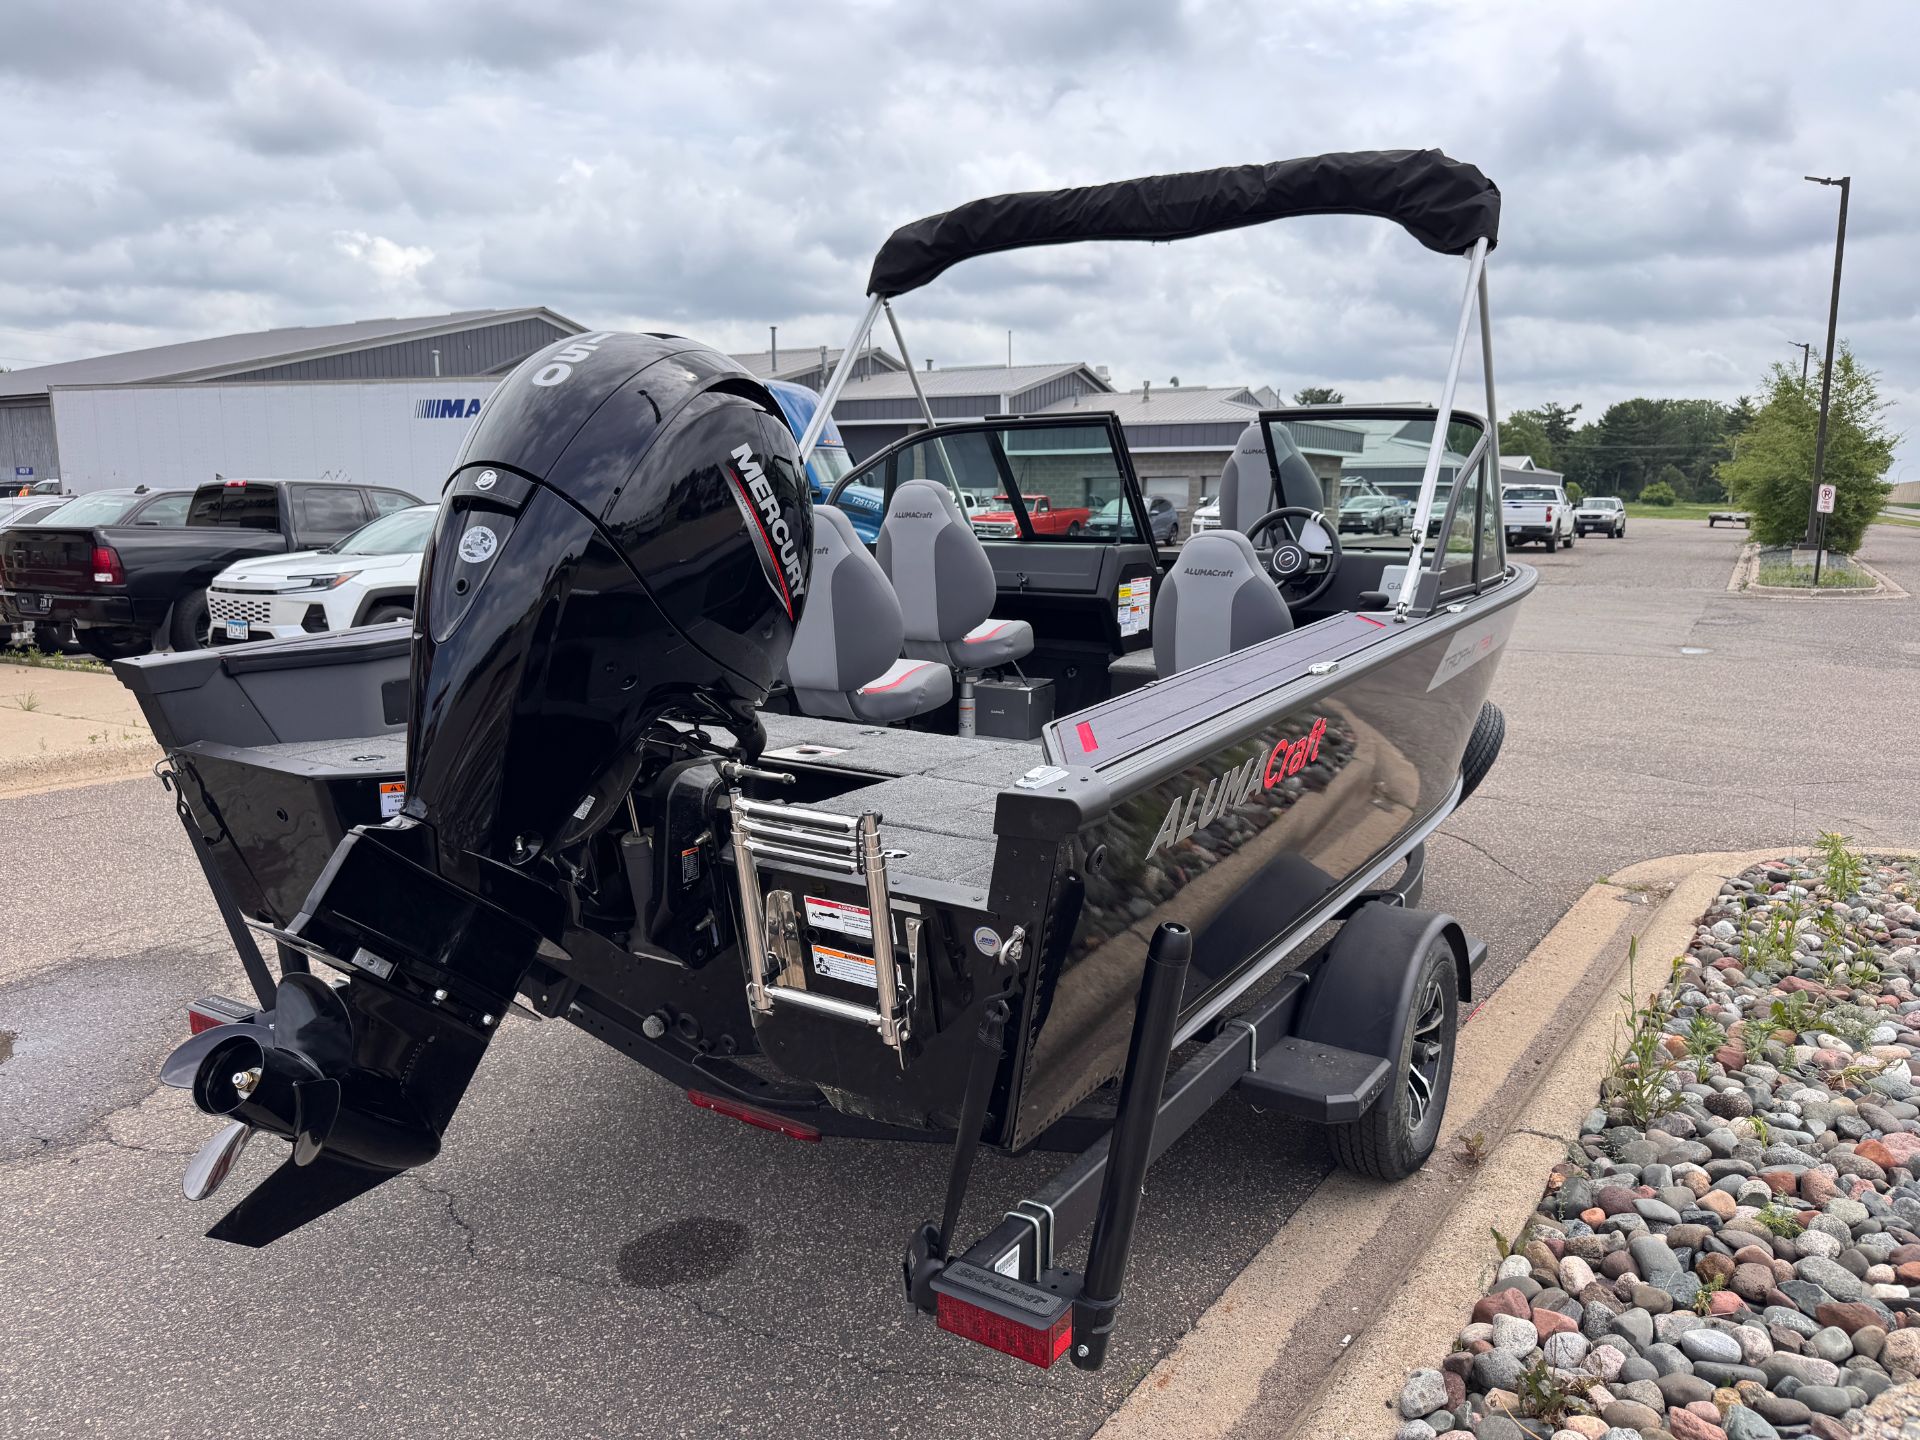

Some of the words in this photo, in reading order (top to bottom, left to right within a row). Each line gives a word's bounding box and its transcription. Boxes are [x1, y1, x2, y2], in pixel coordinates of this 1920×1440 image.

[532, 332, 617, 387] 150
[440, 398, 488, 418] MA
[730, 442, 805, 599] MERCURY
[1183, 567, 1234, 578] ALUMACraft
[1145, 717, 1328, 861] ALUMACraft
